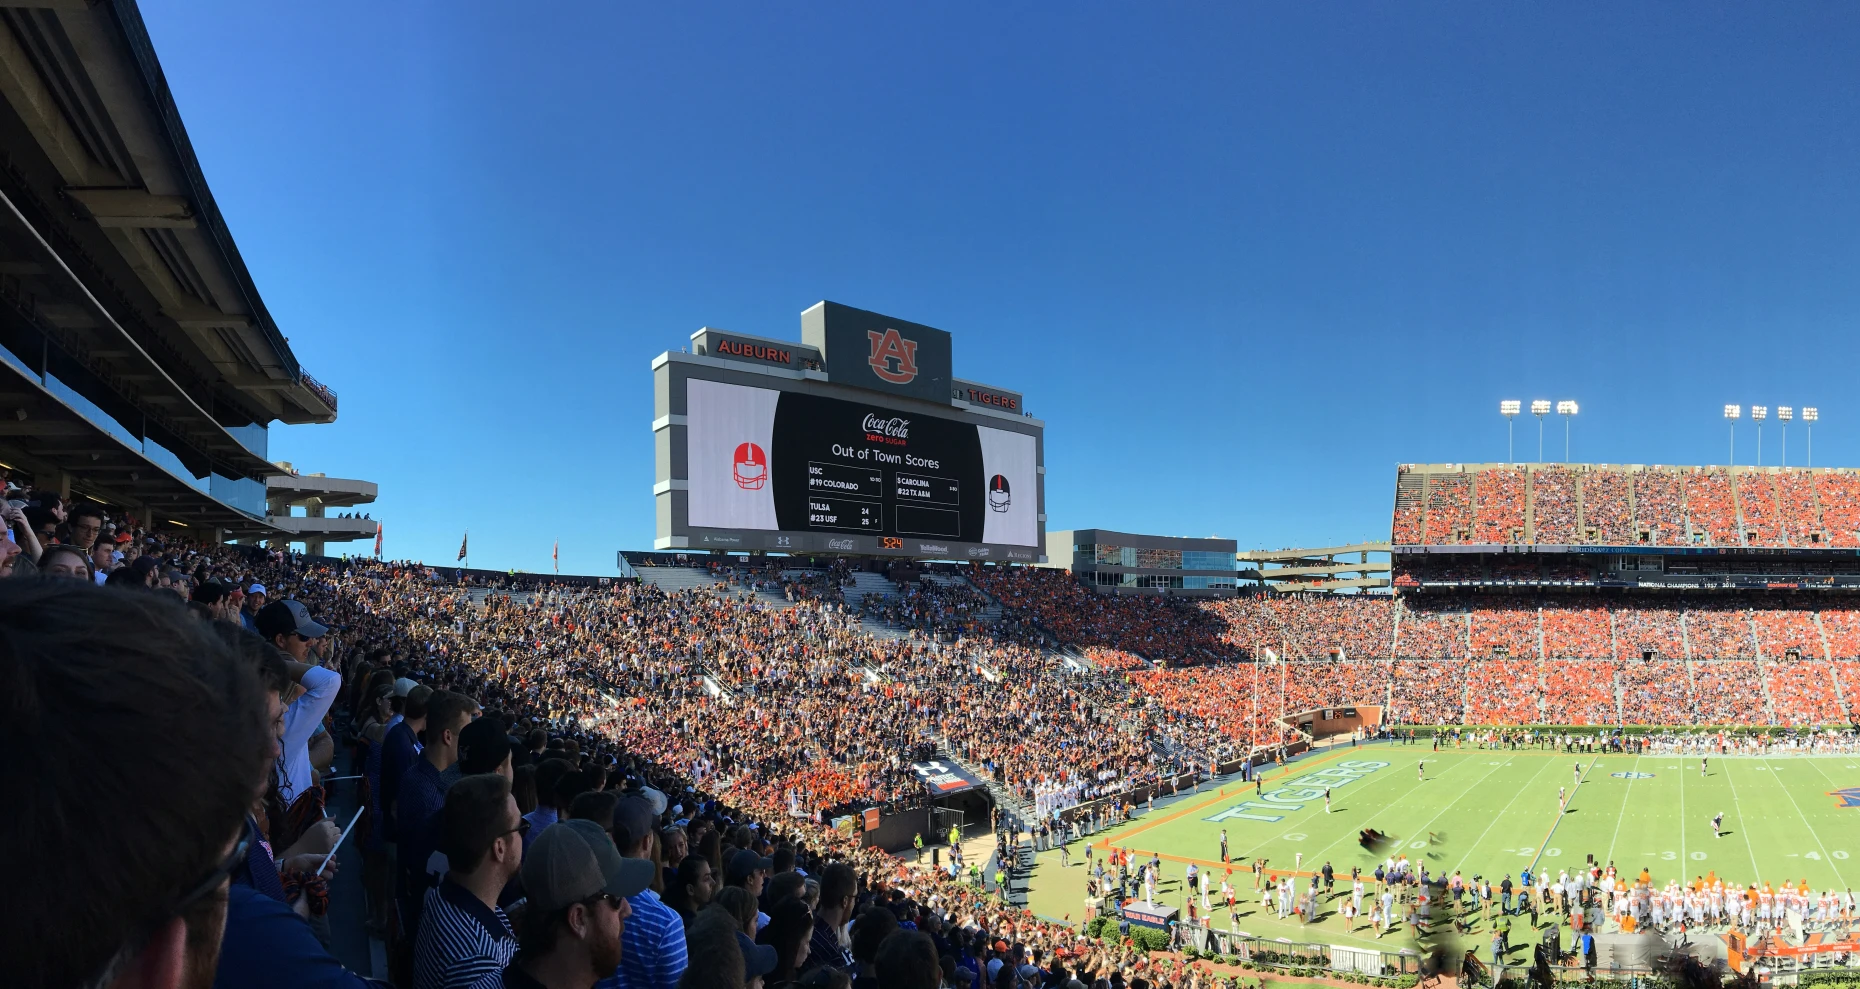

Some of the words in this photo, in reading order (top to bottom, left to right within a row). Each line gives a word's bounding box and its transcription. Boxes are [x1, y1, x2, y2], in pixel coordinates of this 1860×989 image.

[718, 340, 791, 364] AUBURN
[968, 389, 1017, 410] TIGERS
[866, 433, 884, 443] zero
[885, 437, 907, 446] SUGAR
[832, 444, 854, 458] Out
[857, 449, 870, 460] of
[873, 450, 902, 464] Town
[905, 454, 940, 469] Scores
[810, 467, 823, 475] USC
[823, 480, 859, 491] COLORADO
[901, 478, 930, 488] CAROLINA
[910, 489, 918, 497] TX
[810, 502, 831, 512] TULSA
[861, 507, 869, 515] 24
[825, 515, 838, 523] USF
[1201, 760, 1391, 823] TIGERS
